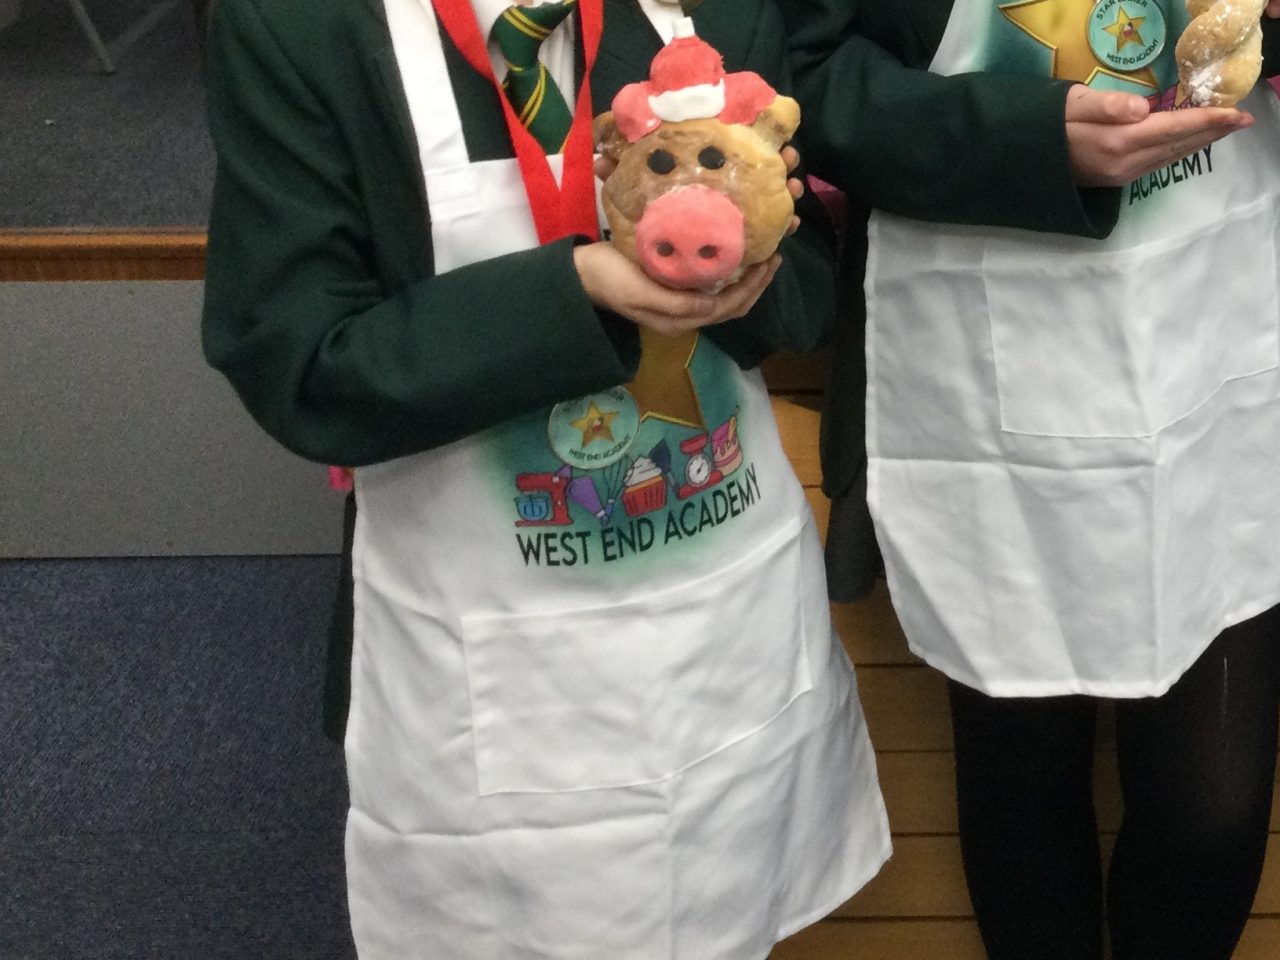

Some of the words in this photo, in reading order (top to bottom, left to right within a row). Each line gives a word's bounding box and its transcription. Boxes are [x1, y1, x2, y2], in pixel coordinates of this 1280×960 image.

[1096, 0, 1116, 20] STAR
[1106, 52, 1122, 64] WEST
[1136, 39, 1159, 62] ACADEMY
[1129, 144, 1212, 205] ACADEMY
[515, 530, 591, 567] WEST
[601, 517, 654, 562] END
[664, 462, 761, 545] ACADEMY
